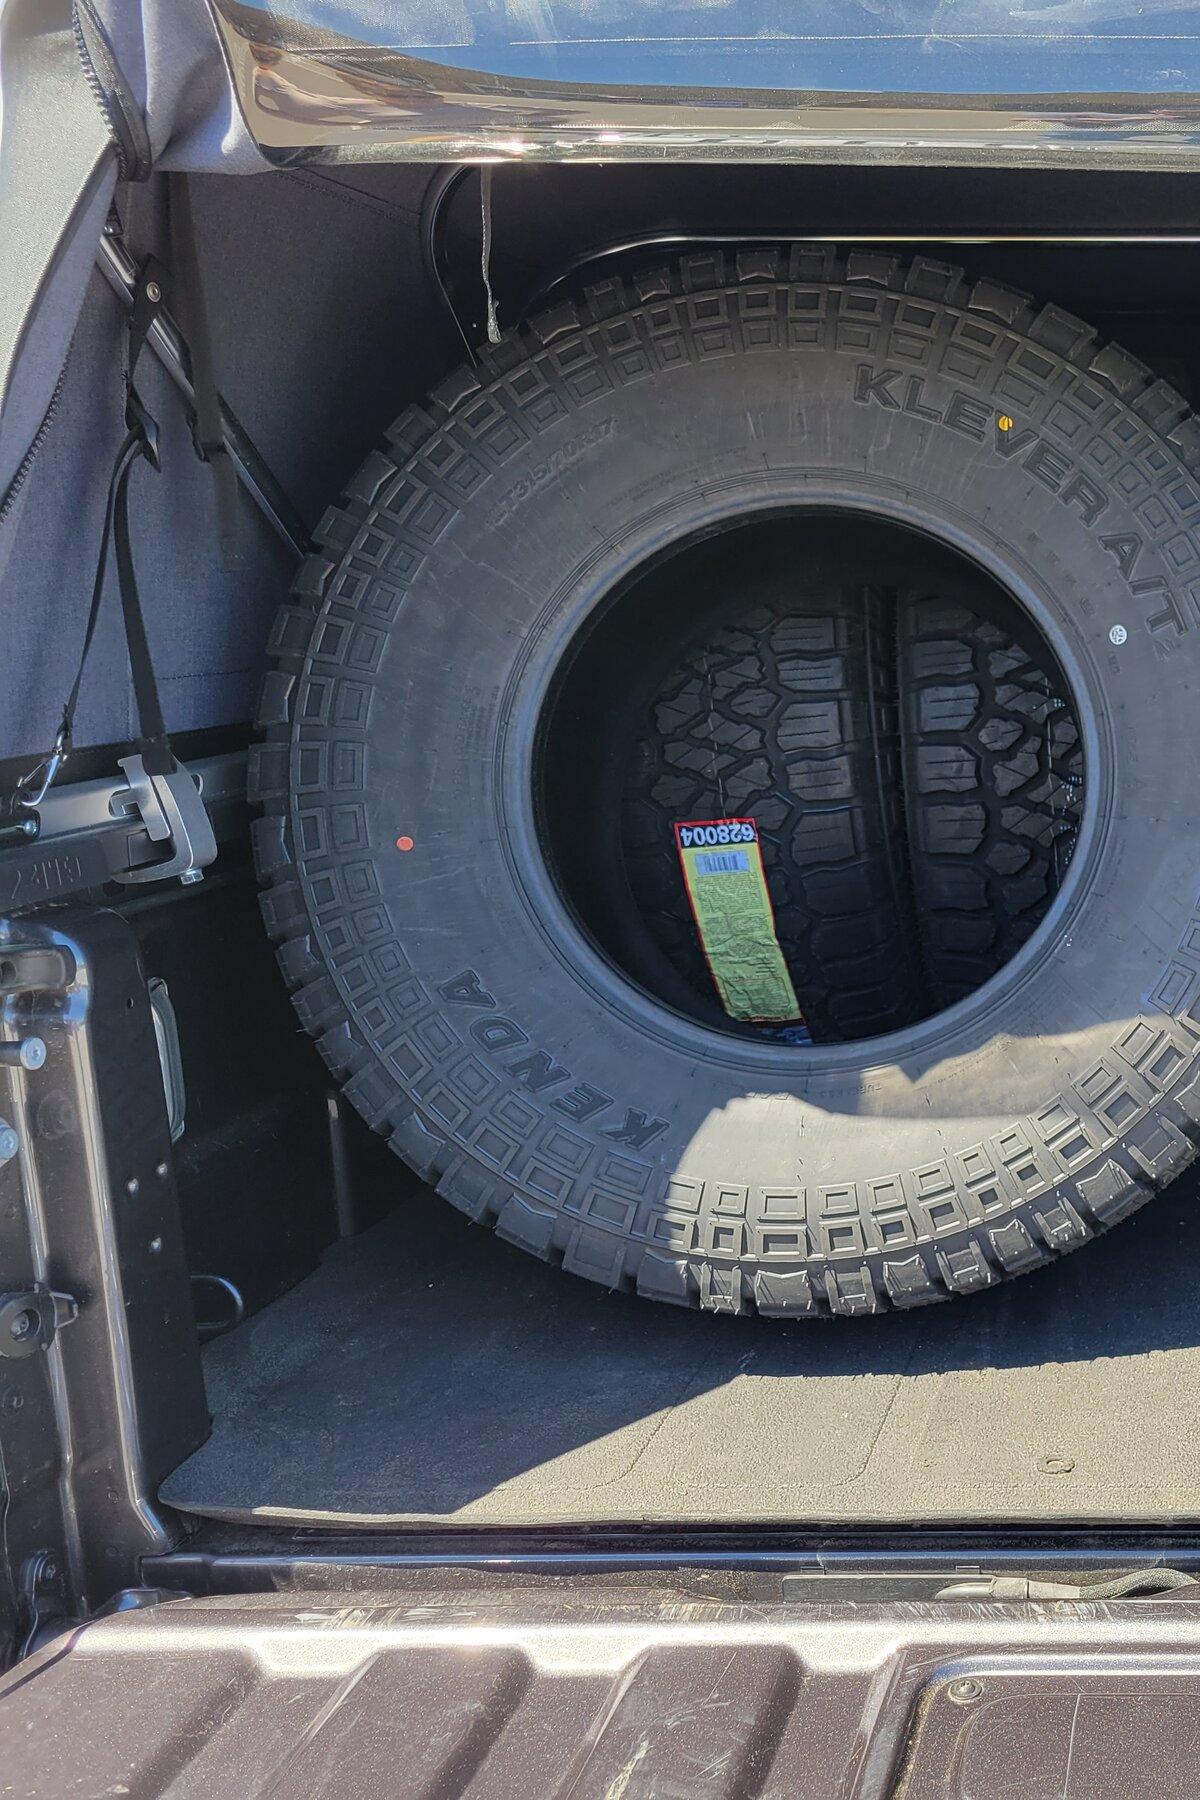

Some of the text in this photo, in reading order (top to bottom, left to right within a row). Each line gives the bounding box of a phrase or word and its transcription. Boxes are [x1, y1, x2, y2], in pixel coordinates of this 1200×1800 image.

[854, 363, 1109, 528] KLEVER
[1099, 532, 1188, 636] A/T
[681, 823, 756, 847] 628004
[437, 968, 671, 1151] KENDA
